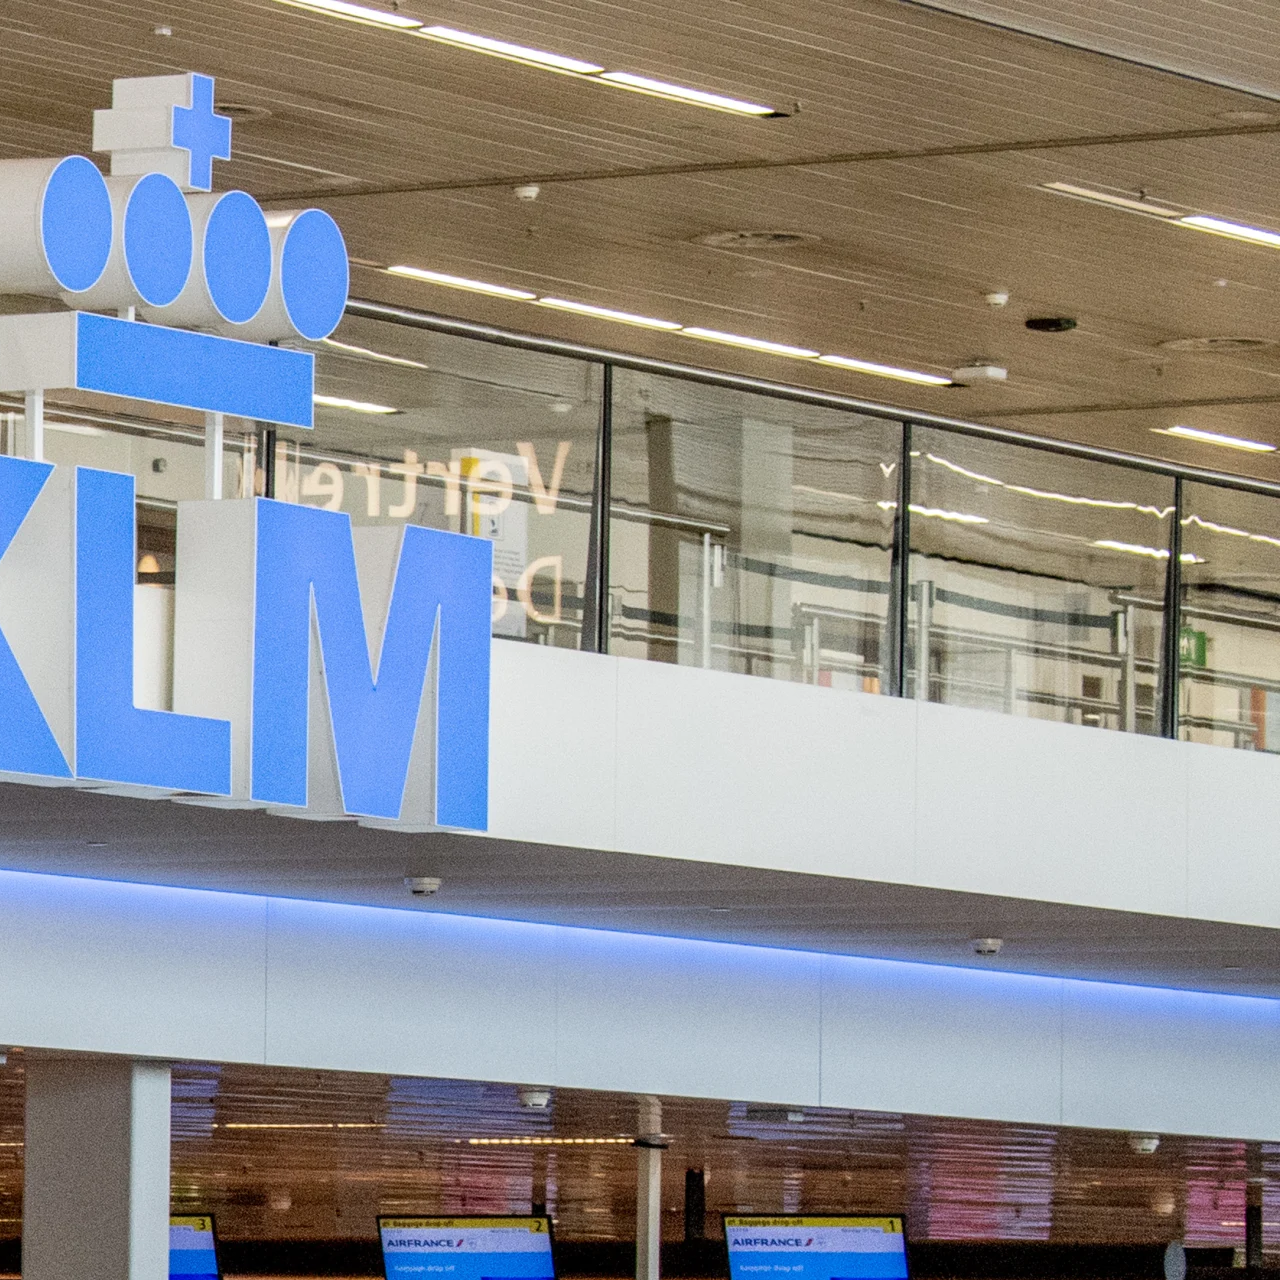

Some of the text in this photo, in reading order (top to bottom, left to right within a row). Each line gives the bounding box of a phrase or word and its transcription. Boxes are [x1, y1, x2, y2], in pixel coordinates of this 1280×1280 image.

[199, 1219, 206, 1230] 3
[535, 1220, 542, 1232] 2
[889, 1220, 896, 1232] 1
[387, 1239, 454, 1247] AIRFRANCE
[732, 1238, 802, 1247] AIRFRANCE
